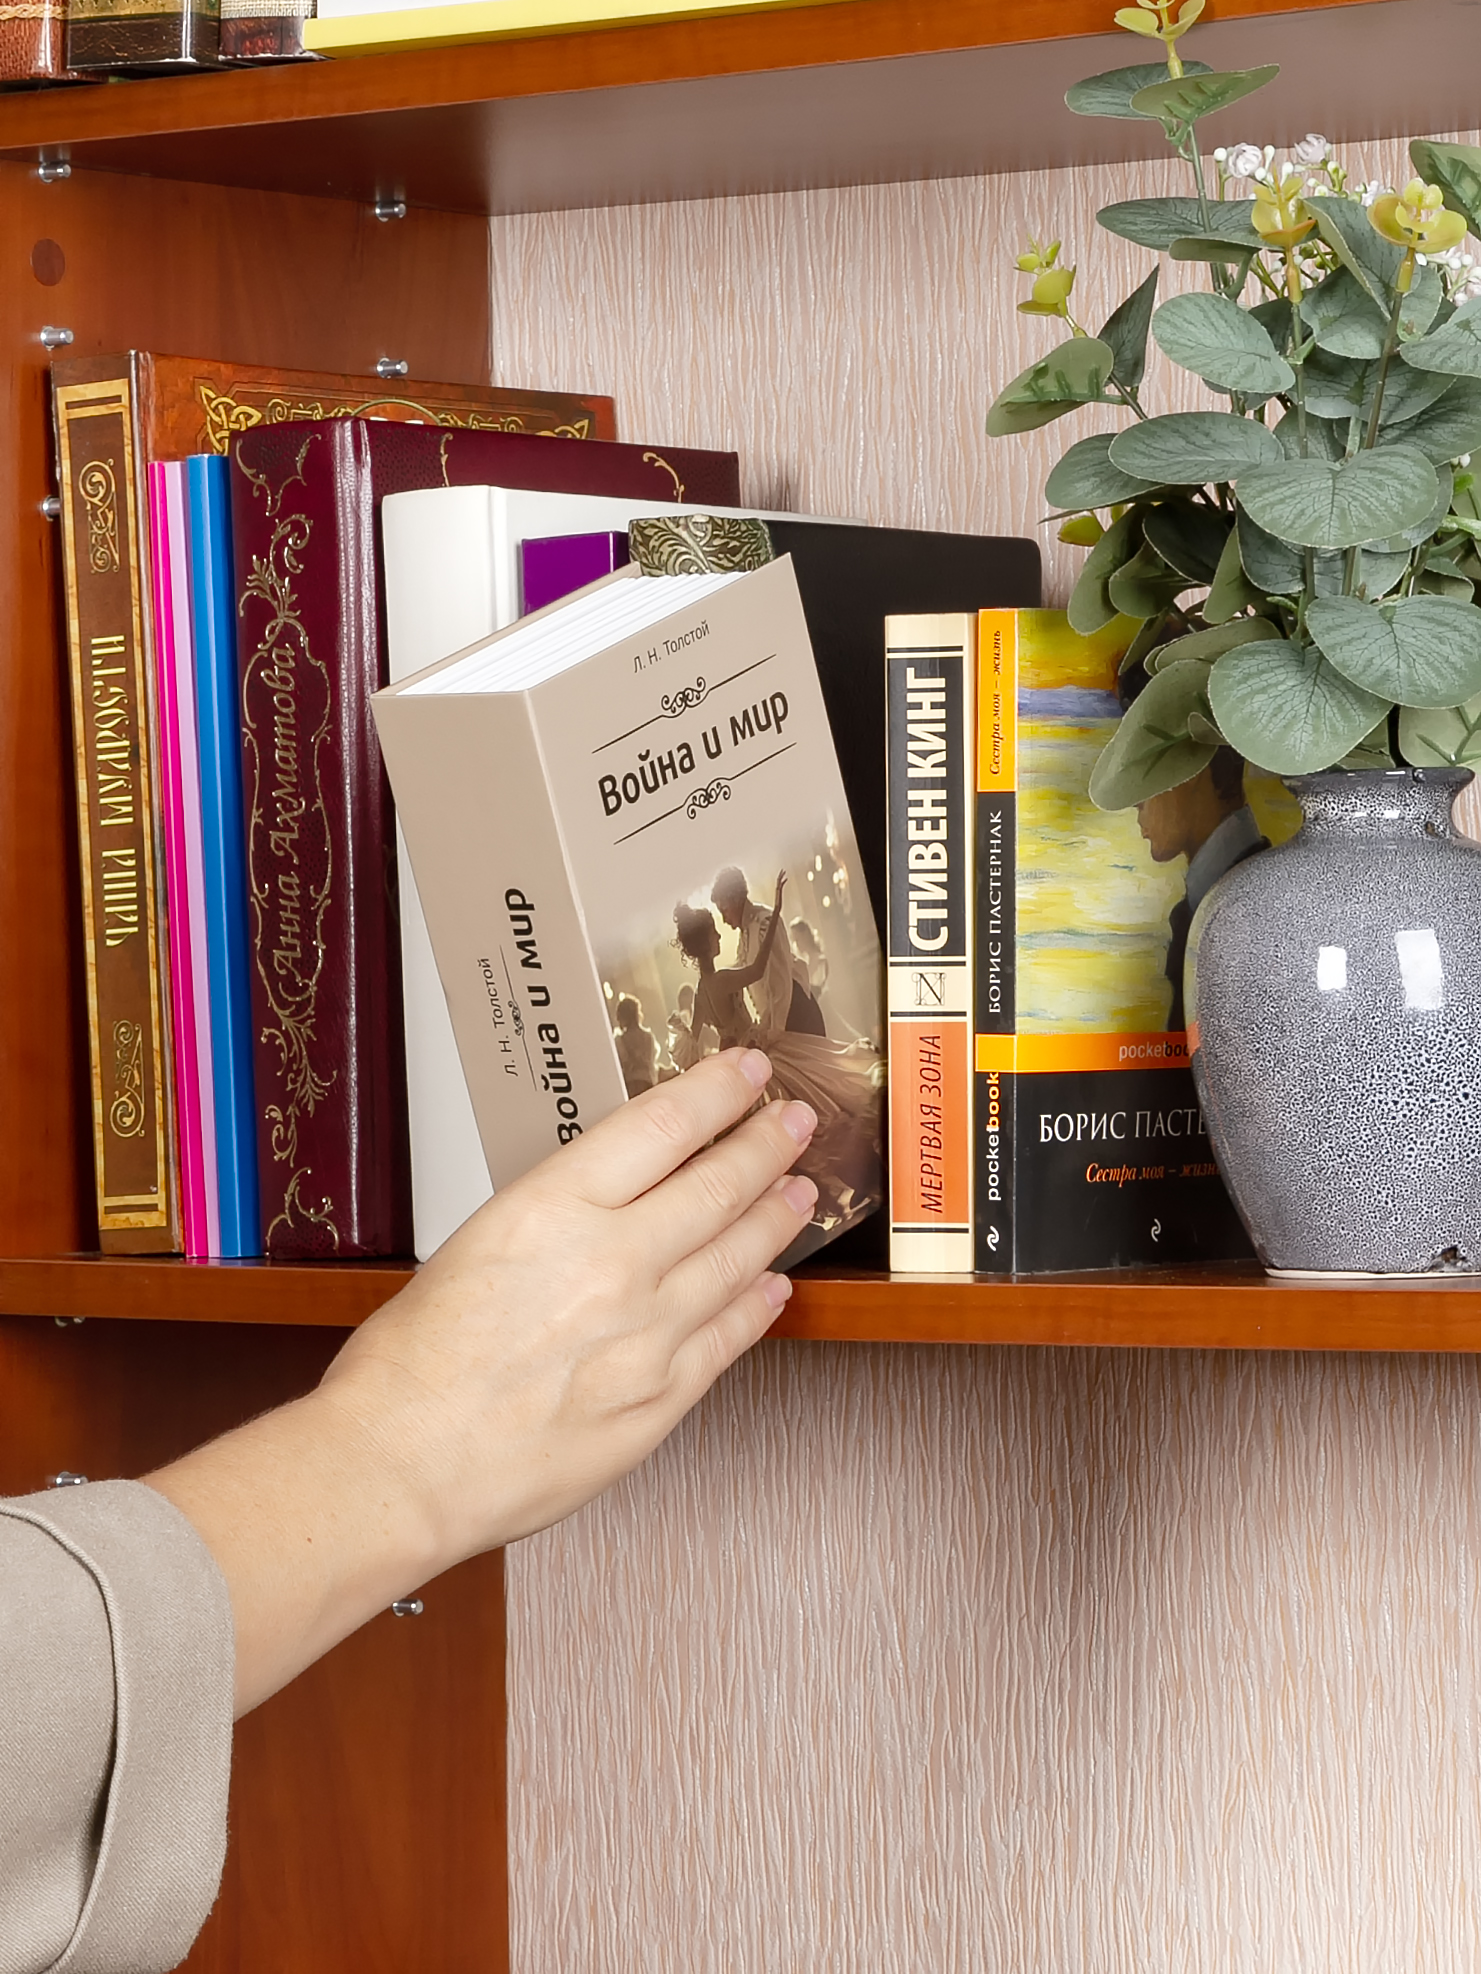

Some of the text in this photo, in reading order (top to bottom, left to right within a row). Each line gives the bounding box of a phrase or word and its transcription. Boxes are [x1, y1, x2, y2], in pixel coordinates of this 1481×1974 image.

[632, 619, 711, 673] Л. Н. Толстой
[992, 630, 1002, 677] жизнь
[993, 692, 1002, 719] моя
[91, 635, 139, 947] ЧАША МУДРОСТИ
[259, 642, 306, 976] Анна Ахматова
[597, 691, 789, 817] Война и мир
[906, 667, 949, 952] СТИВЕН КИНГ
[988, 720, 1006, 776] Сестра
[988, 810, 1003, 1014] БОРИС ПАСТЕРНАК
[476, 957, 518, 1077] Л. Н. Толстой
[504, 887, 585, 1147] Война и мир
[919, 1034, 944, 1214] МЕРТВАЯ ЗОНА
[986, 1071, 1002, 1202] pocketbook
[1039, 1110, 1127, 1143] БОРИС
[1085, 1162, 1136, 1188] Сестра
[1138, 1164, 1165, 1181] моя
